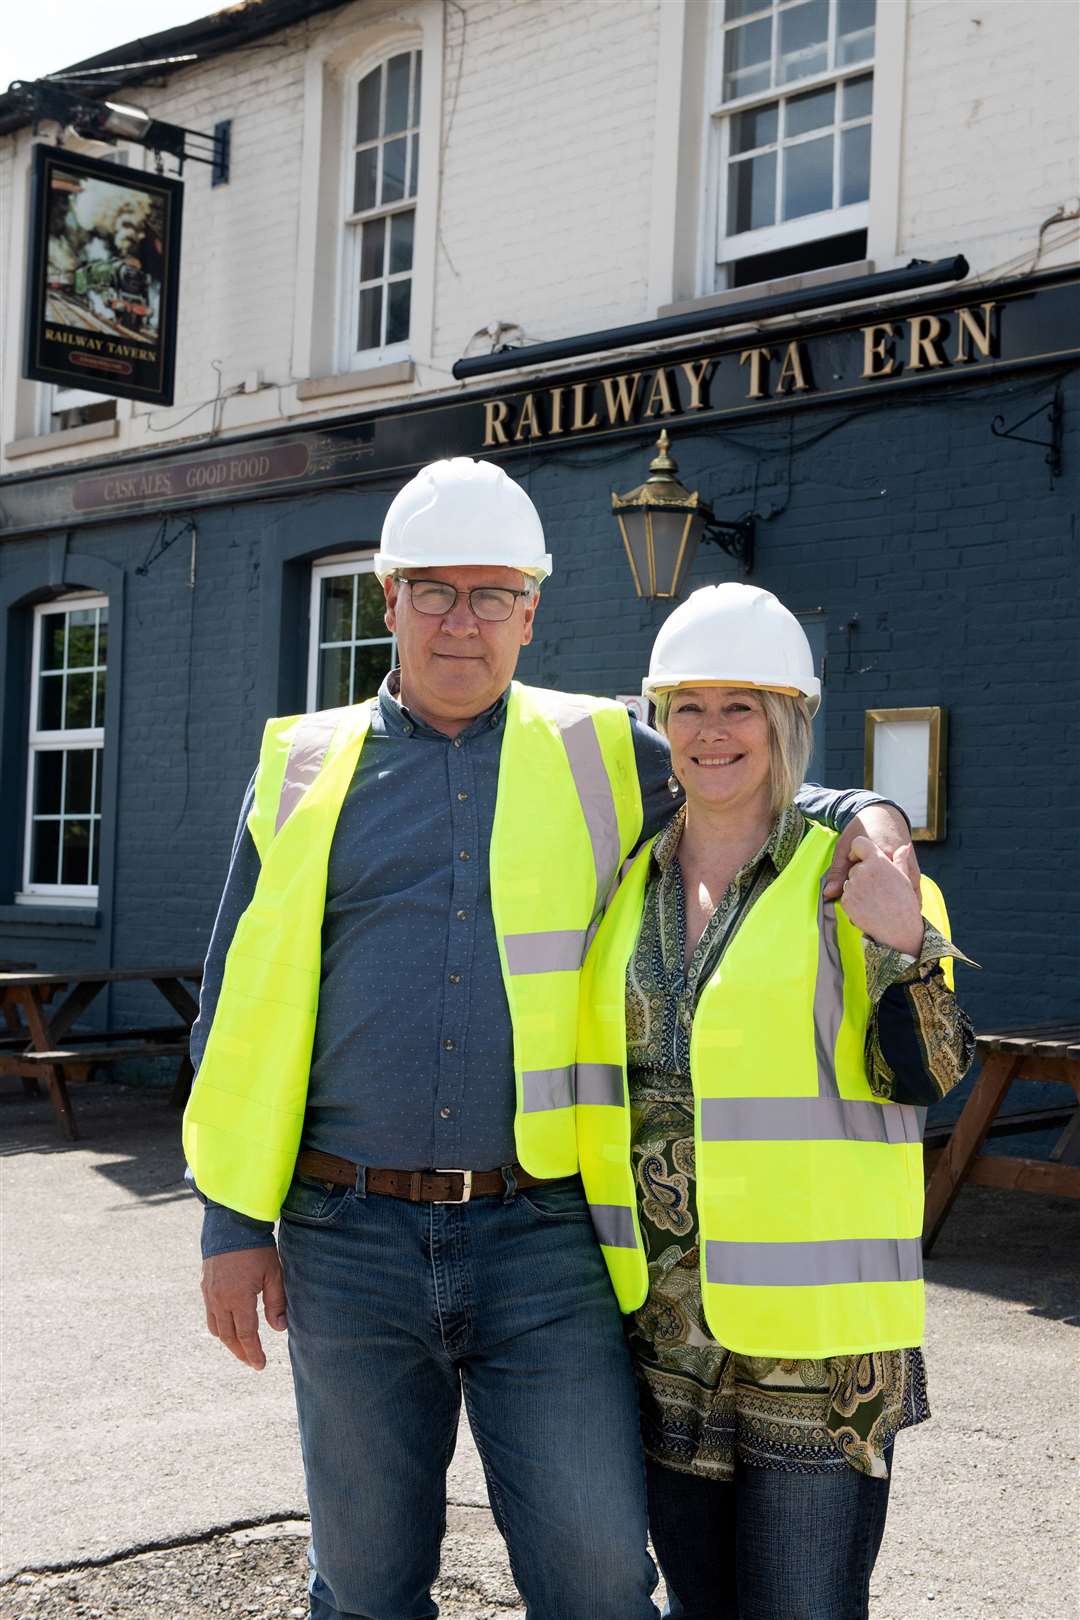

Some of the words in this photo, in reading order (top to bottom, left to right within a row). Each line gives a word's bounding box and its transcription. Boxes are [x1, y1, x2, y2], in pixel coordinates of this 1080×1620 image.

[45, 328, 103, 350] RAILWAY
[106, 341, 157, 361] TAVERN
[484, 358, 715, 447] RAILWAY
[104, 479, 137, 502] CASK
[136, 472, 171, 496] ALES
[186, 465, 226, 488] GOOD
[229, 456, 270, 481] FOOD
